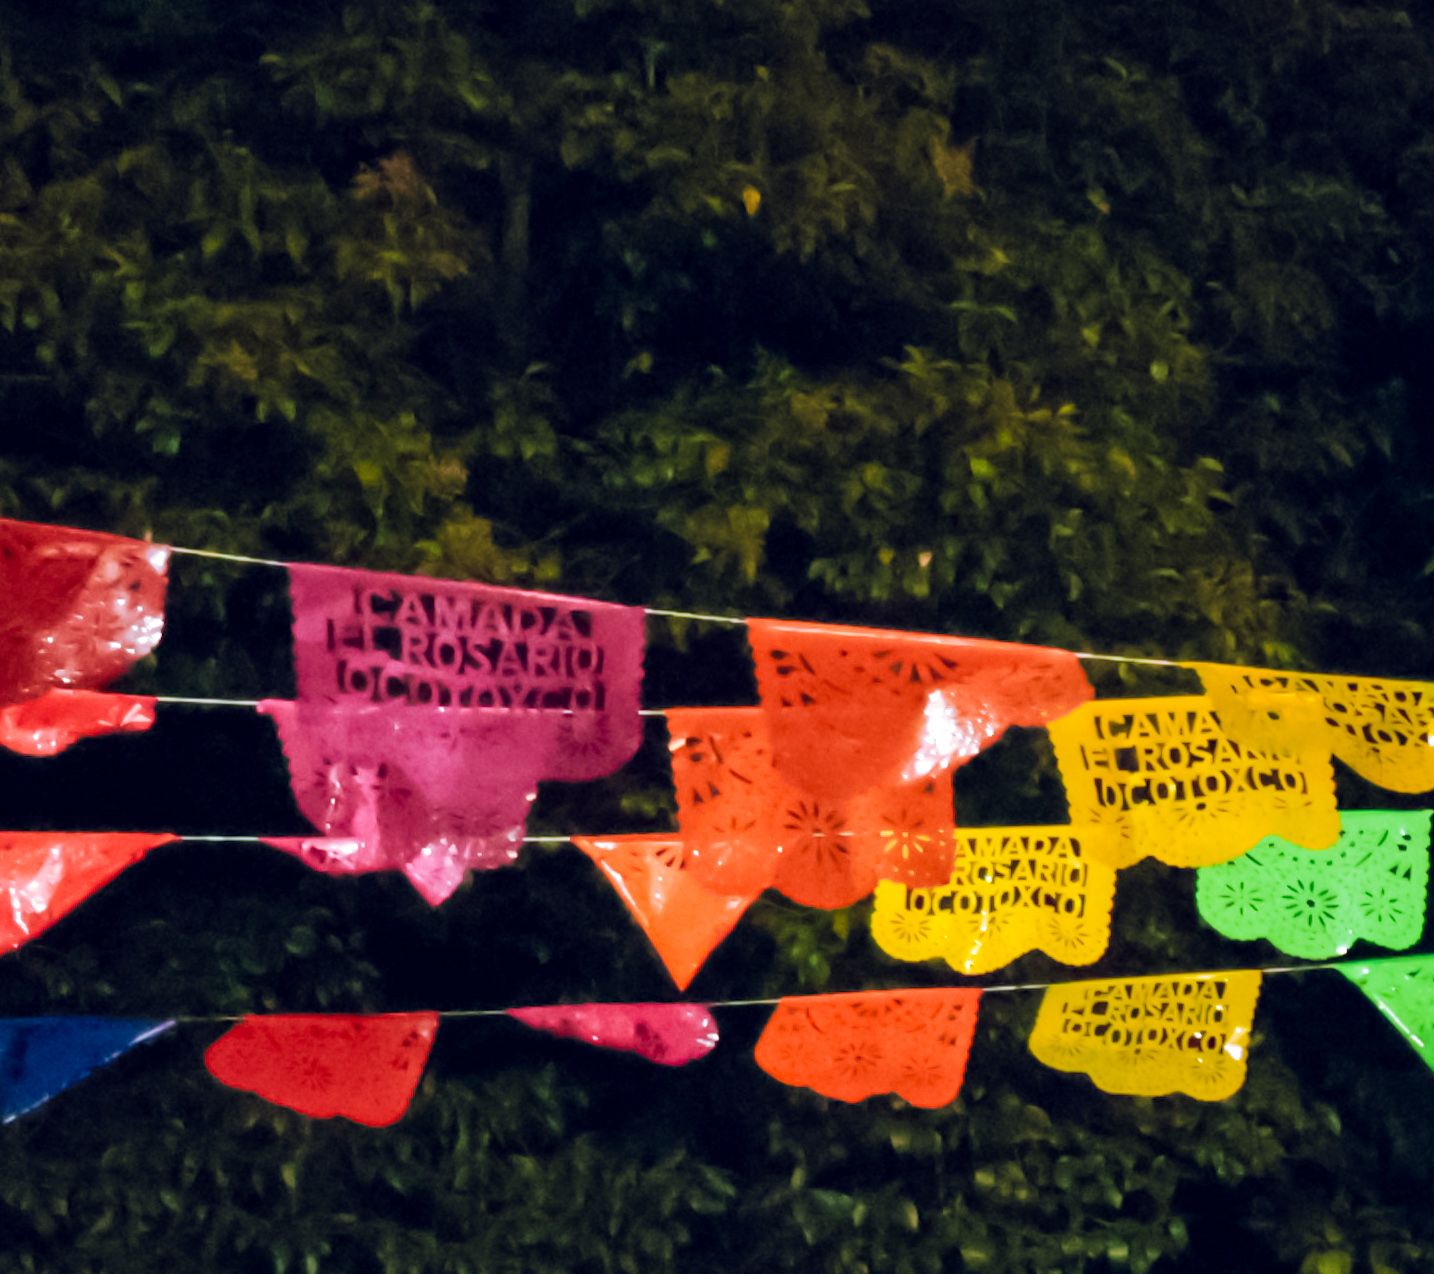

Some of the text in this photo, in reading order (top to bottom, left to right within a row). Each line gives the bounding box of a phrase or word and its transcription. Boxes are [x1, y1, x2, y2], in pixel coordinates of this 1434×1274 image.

[354, 588, 593, 638] CAMADA
[327, 619, 604, 677] EL ROSARIO
[1096, 711, 1225, 740] CAMA
[1082, 743, 1138, 771] EL
[1095, 770, 1310, 811] OCOTOXCO
[957, 836, 1083, 860] AMADA
[905, 885, 1086, 918] OCOTOXCO
